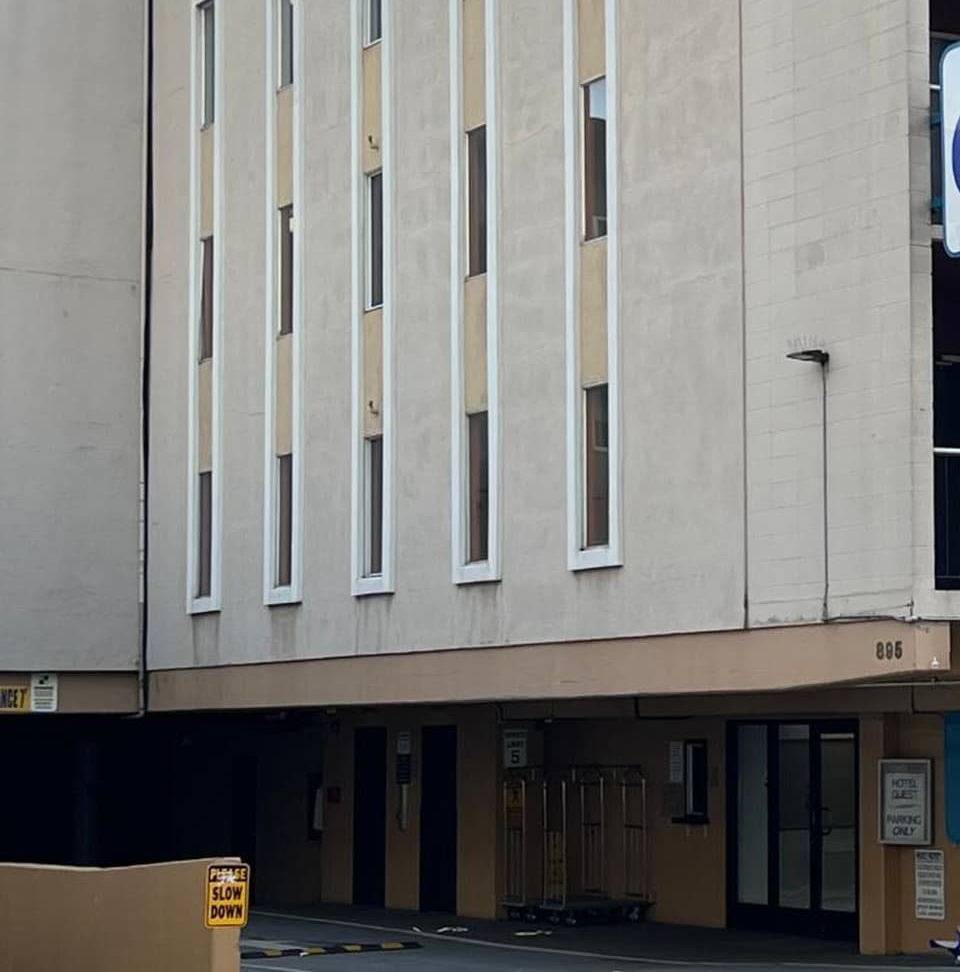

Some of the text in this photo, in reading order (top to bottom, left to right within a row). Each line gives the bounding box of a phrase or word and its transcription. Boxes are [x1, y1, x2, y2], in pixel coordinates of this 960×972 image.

[876, 640, 903, 660] 895
[511, 750, 520, 765] 5
[891, 779, 919, 789] HOTEL
[891, 790, 919, 800] GUEST
[886, 815, 922, 826] PARKING
[892, 826, 917, 837] ONLY
[212, 886, 244, 901] SLOW
[211, 905, 243, 920] DOWN
